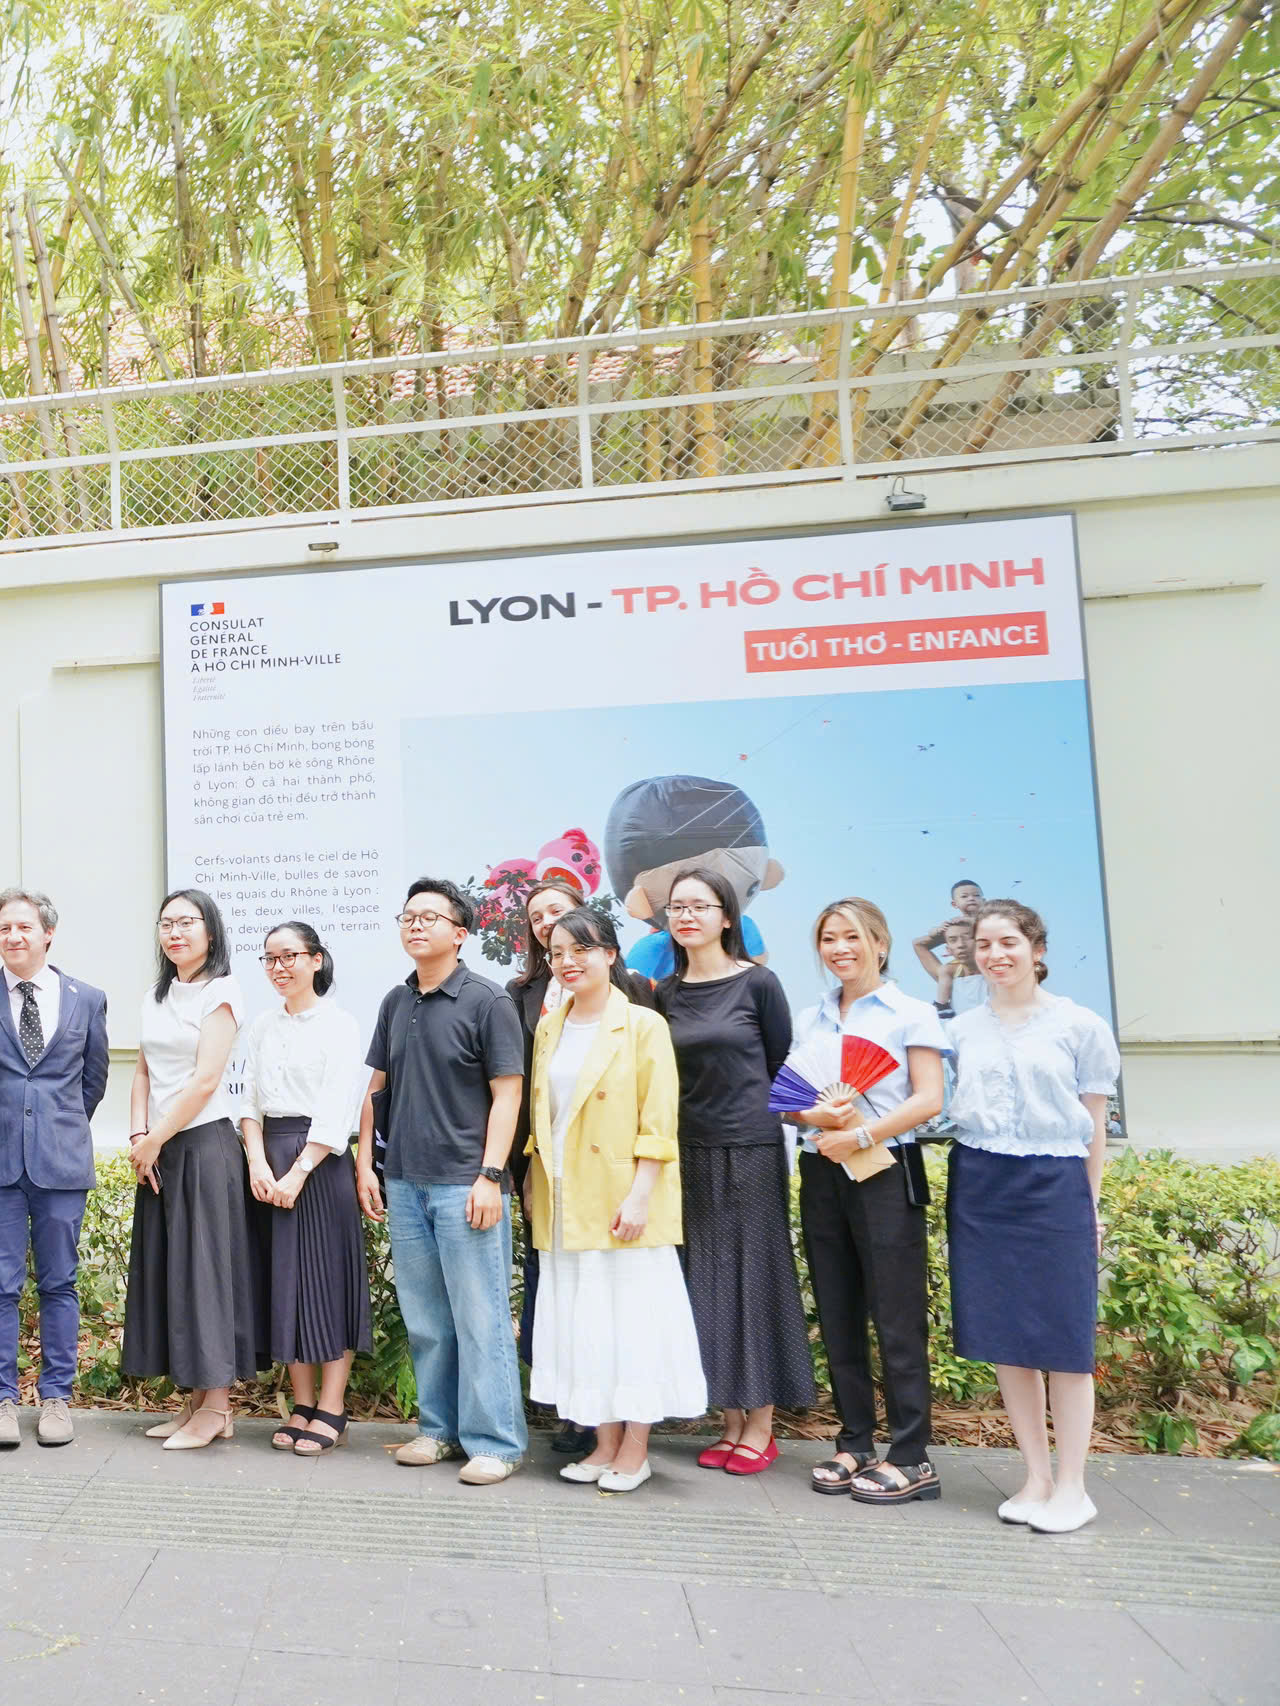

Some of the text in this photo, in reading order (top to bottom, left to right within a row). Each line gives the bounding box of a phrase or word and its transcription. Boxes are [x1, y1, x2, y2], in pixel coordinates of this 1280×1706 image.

[449, 592, 576, 626] LYON
[611, 585, 688, 614] TP.
[699, 566, 780, 608] HỒ
[792, 563, 889, 602] CHÍ
[899, 557, 1045, 595] MINH
[190, 617, 264, 632] CONSULAT
[190, 632, 254, 646] GÉNÉRAL
[751, 632, 817, 661] TUỔI
[824, 632, 887, 657] THƠ
[907, 625, 1039, 651] ENFANCE
[191, 645, 268, 659] DE FRANCE
[191, 660, 200, 673] À
[230, 659, 256, 671] CHI
[261, 653, 341, 669] MINH-VILLE
[282, 775, 300, 786] hai
[231, 795, 256, 809] gian
[194, 854, 271, 866] Cerfs-volants
[273, 853, 301, 863] dans
[304, 852, 315, 862] le
[318, 850, 339, 862] ciel
[341, 850, 357, 861] de
[195, 872, 215, 884] Chi
[284, 868, 319, 880] bulles
[323, 868, 339, 879] de
[344, 869, 379, 878] savon
[217, 889, 232, 900] les
[236, 888, 267, 901] quais
[270, 887, 286, 898] du
[290, 886, 328, 897] Rhône
[343, 885, 371, 899] Lyon
[231, 906, 247, 917] les
[255, 904, 284, 916] deux
[320, 922, 336, 932] un
[341, 919, 381, 931] terrain
[235, 941, 262, 952] pour
